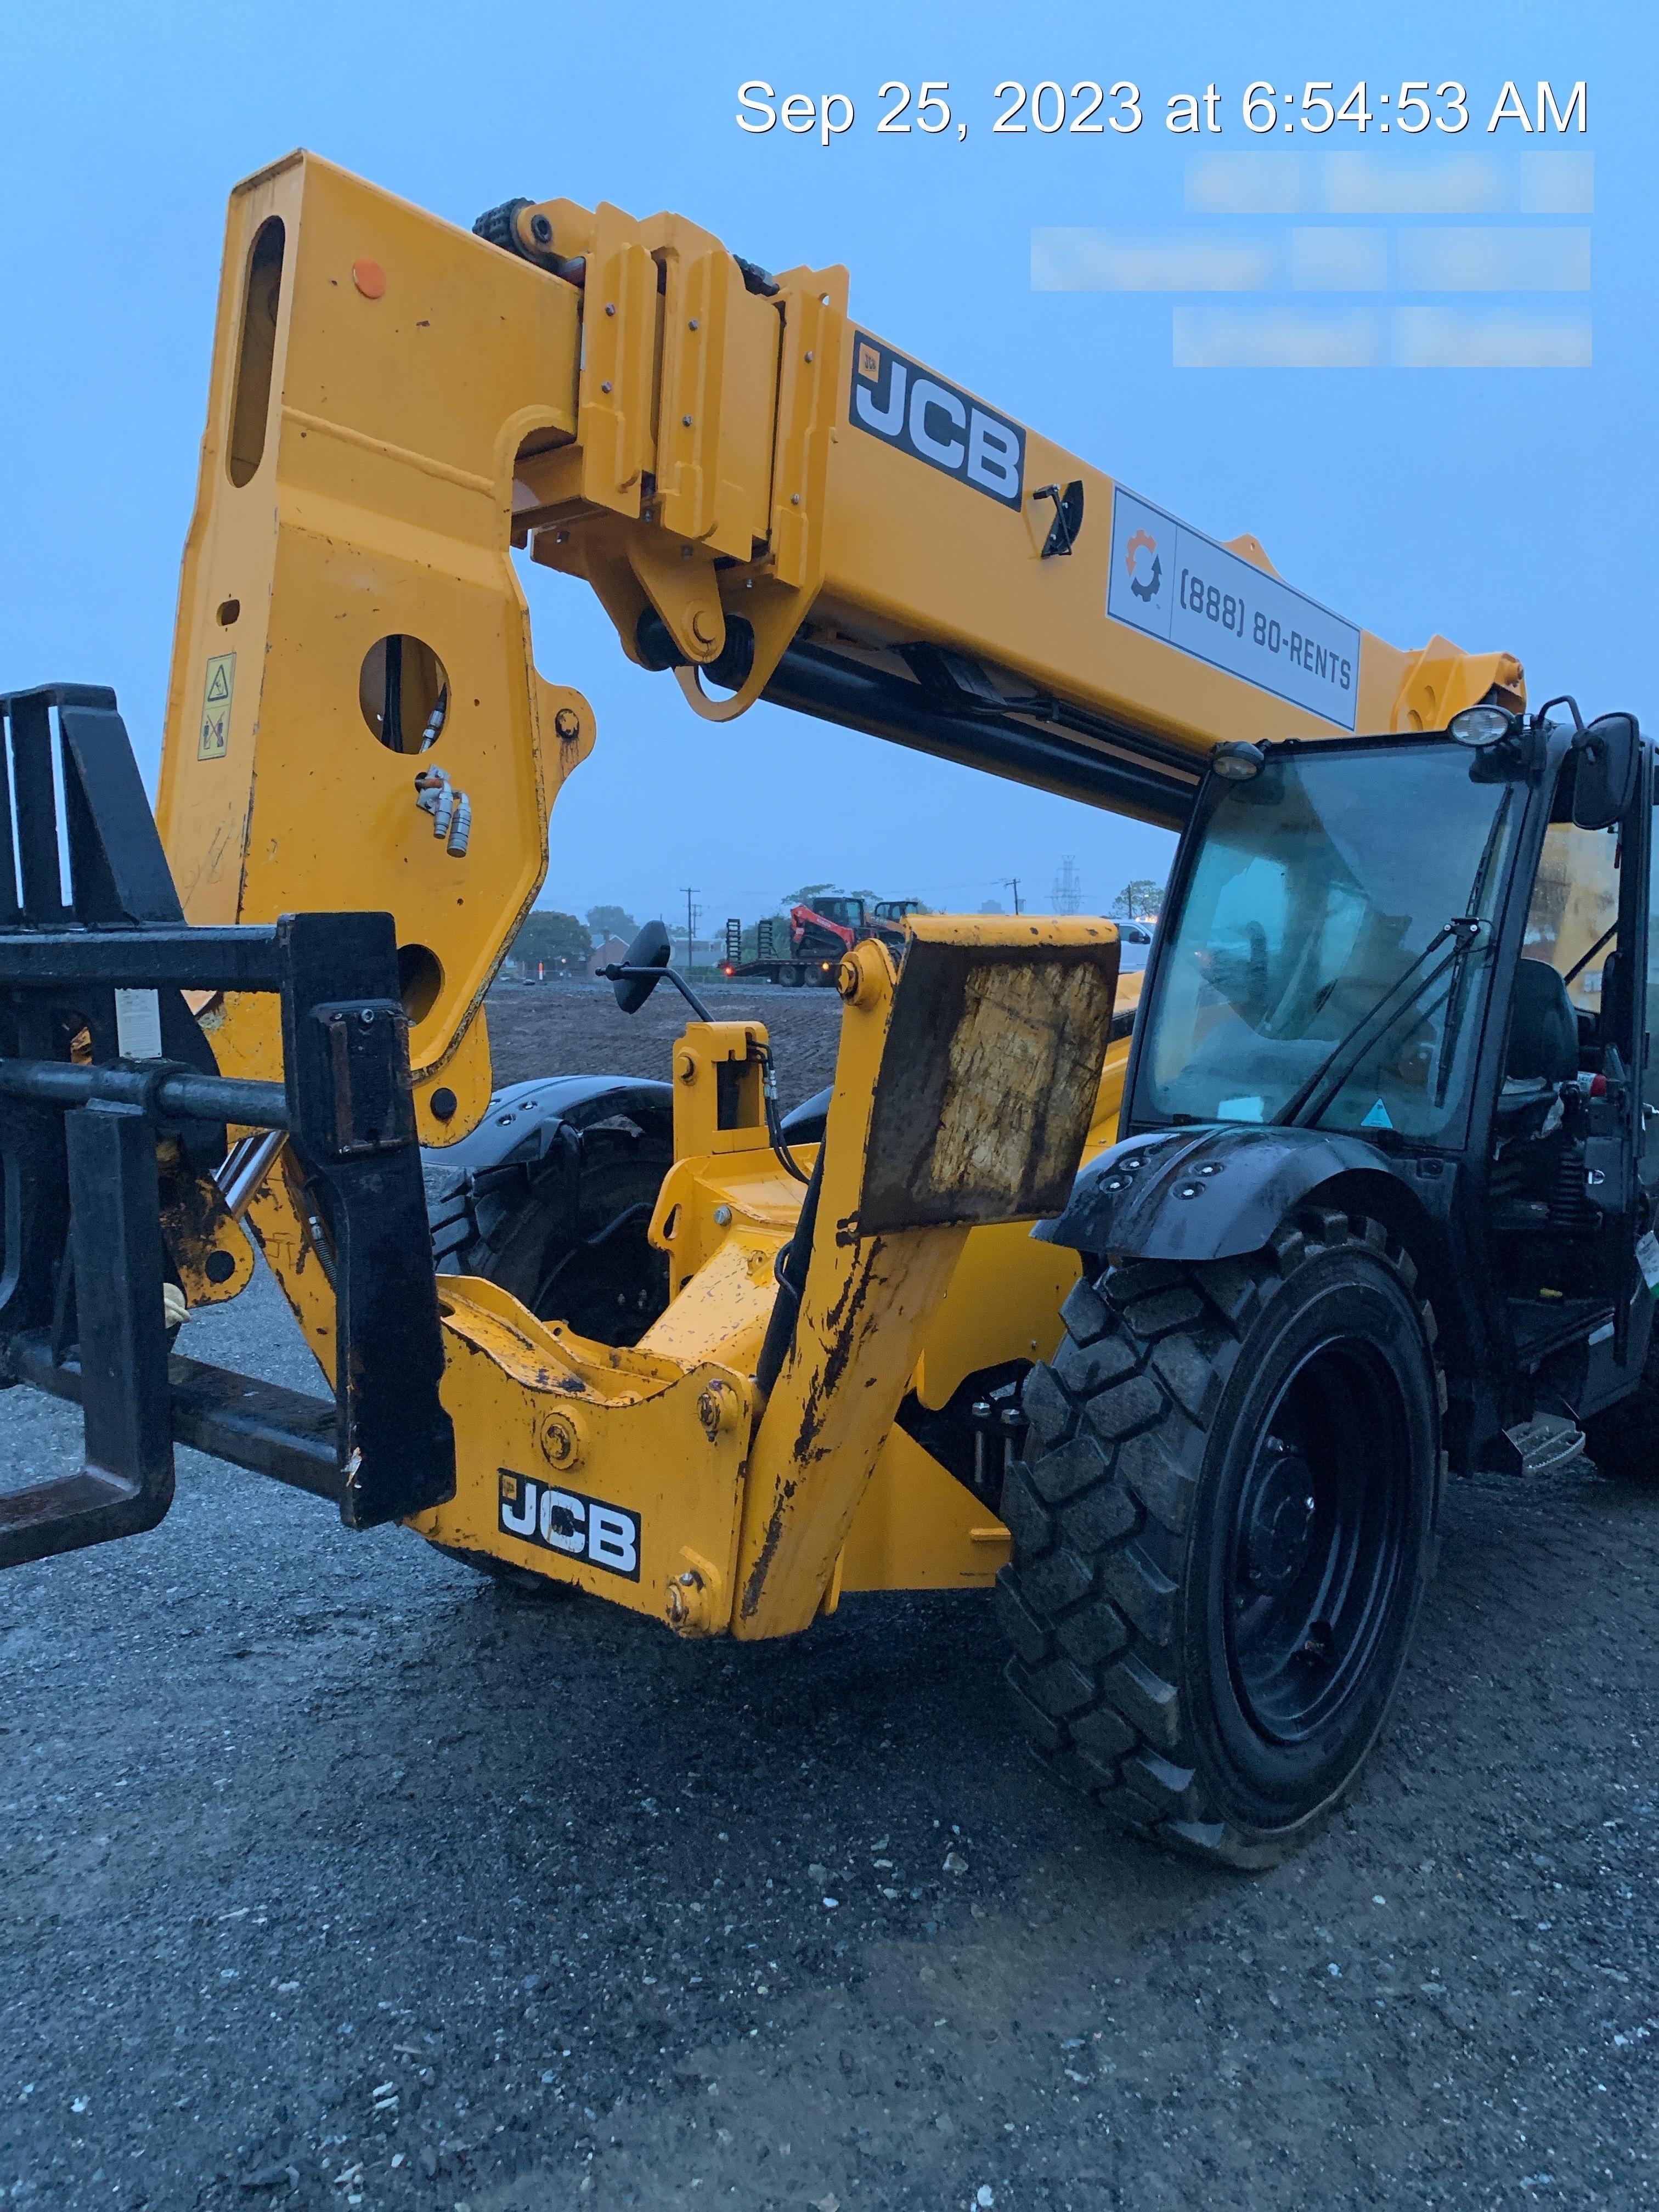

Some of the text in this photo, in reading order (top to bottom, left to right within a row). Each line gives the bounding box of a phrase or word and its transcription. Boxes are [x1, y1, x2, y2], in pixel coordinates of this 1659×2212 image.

[856, 361, 1020, 498] JCB
[1181, 568, 1351, 690] (888) 80-RENTS
[502, 1483, 636, 1572] JCB
